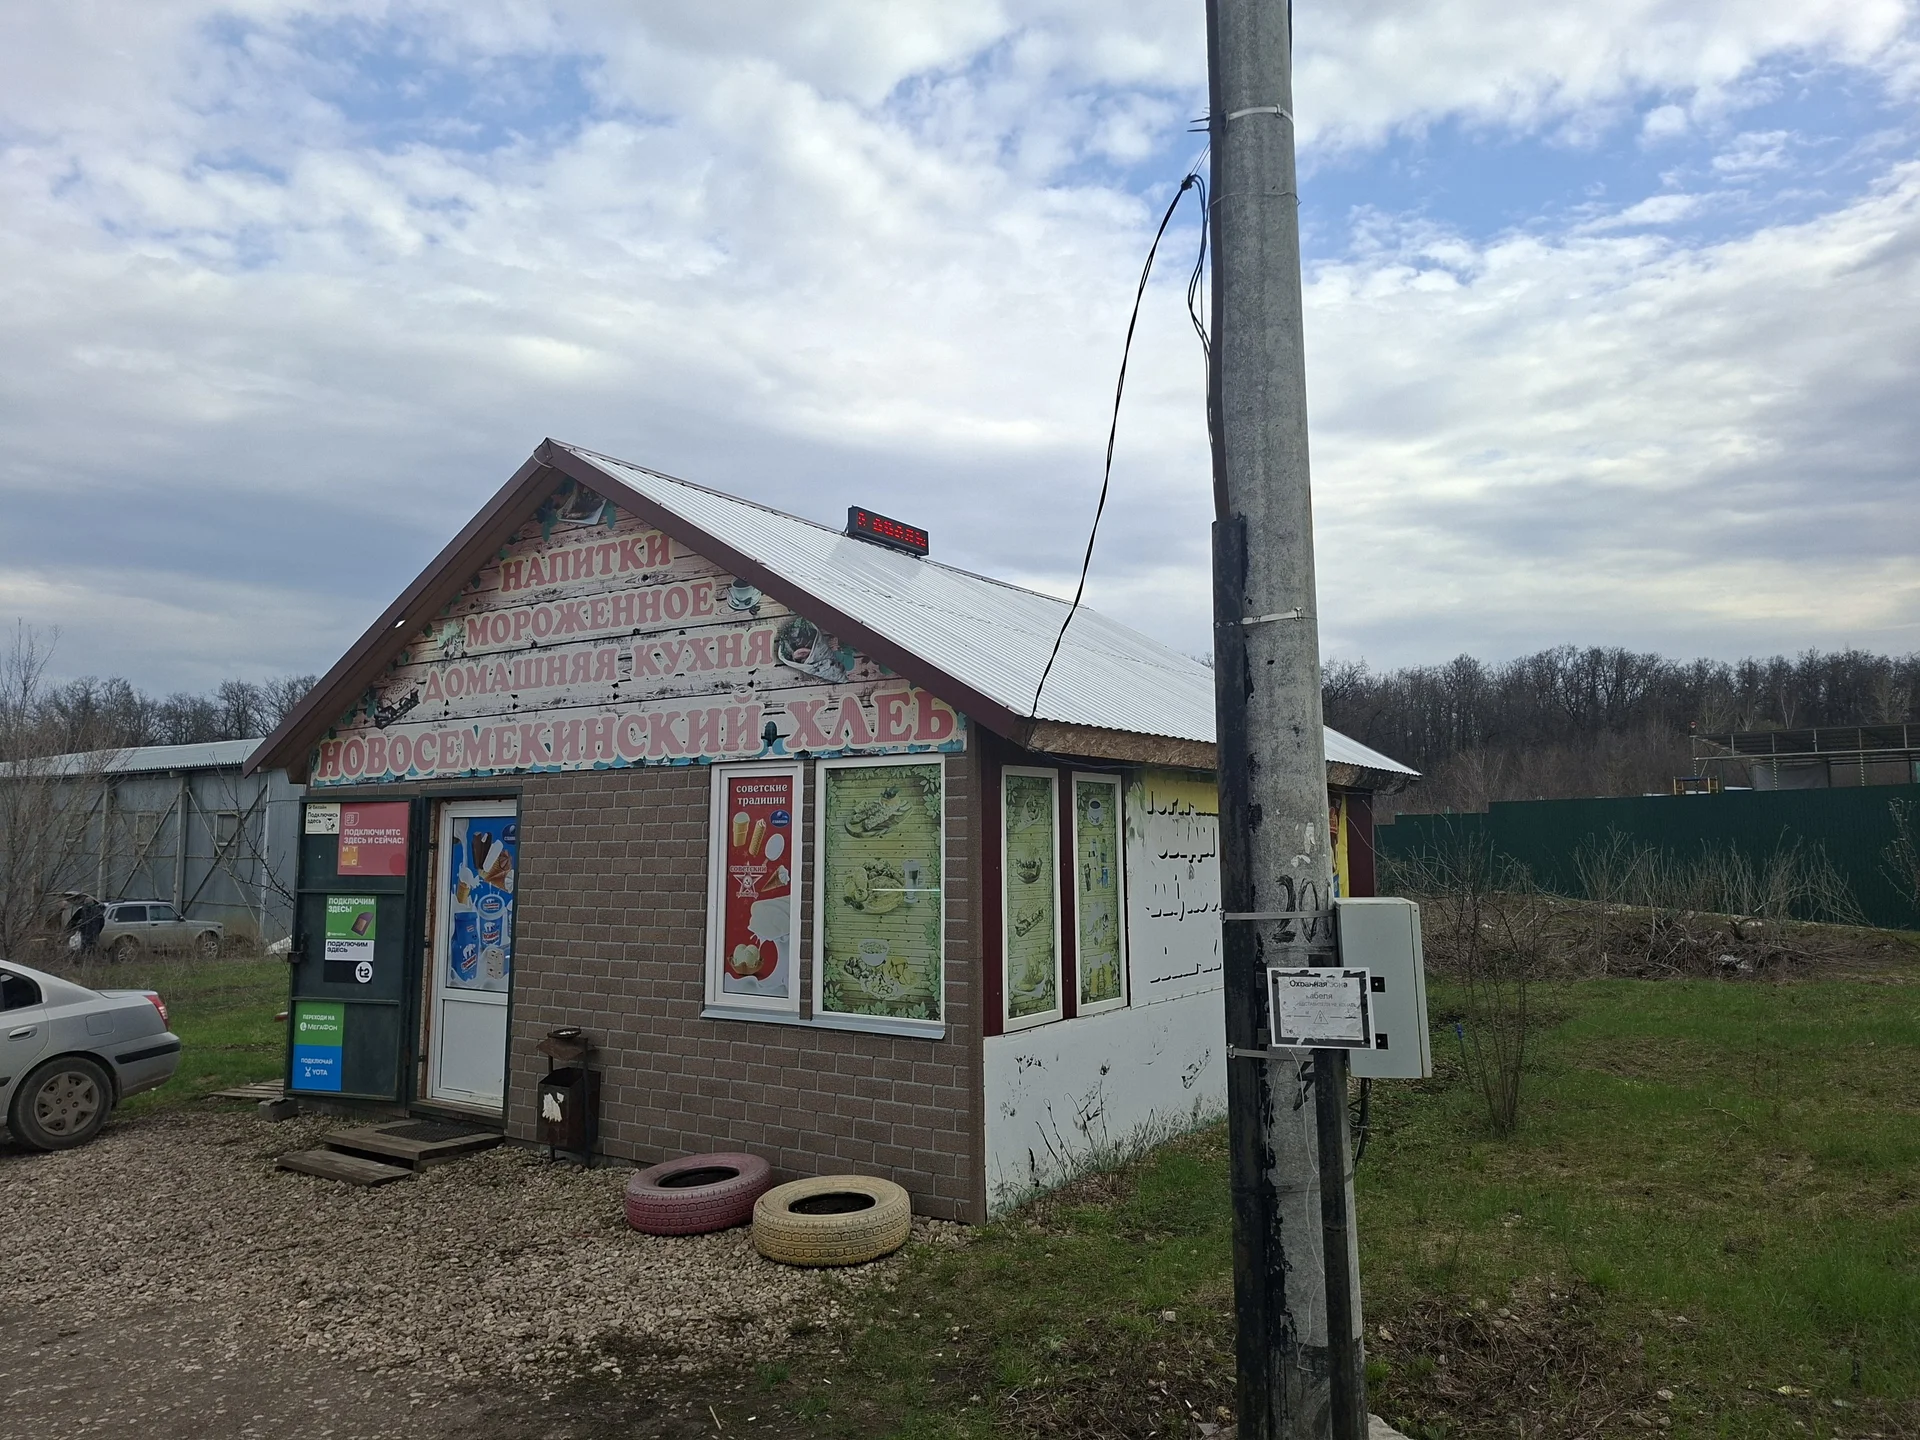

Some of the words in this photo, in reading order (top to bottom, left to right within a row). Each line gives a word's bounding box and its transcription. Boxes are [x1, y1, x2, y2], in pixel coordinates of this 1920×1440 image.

[499, 532, 673, 593] НАПИТКИ
[464, 580, 717, 649] МОРОЖЕННОЕ
[421, 647, 618, 705] ДОМАШНЯЯ
[631, 628, 776, 678] КУХНЯ
[317, 691, 763, 779] НОВОСЕМЕКИНСКИЙ
[785, 690, 958, 749] ХЛЕБ
[736, 784, 788, 793] советские
[738, 796, 786, 807] традиции
[374, 836, 404, 844] СЕЙЧАС!
